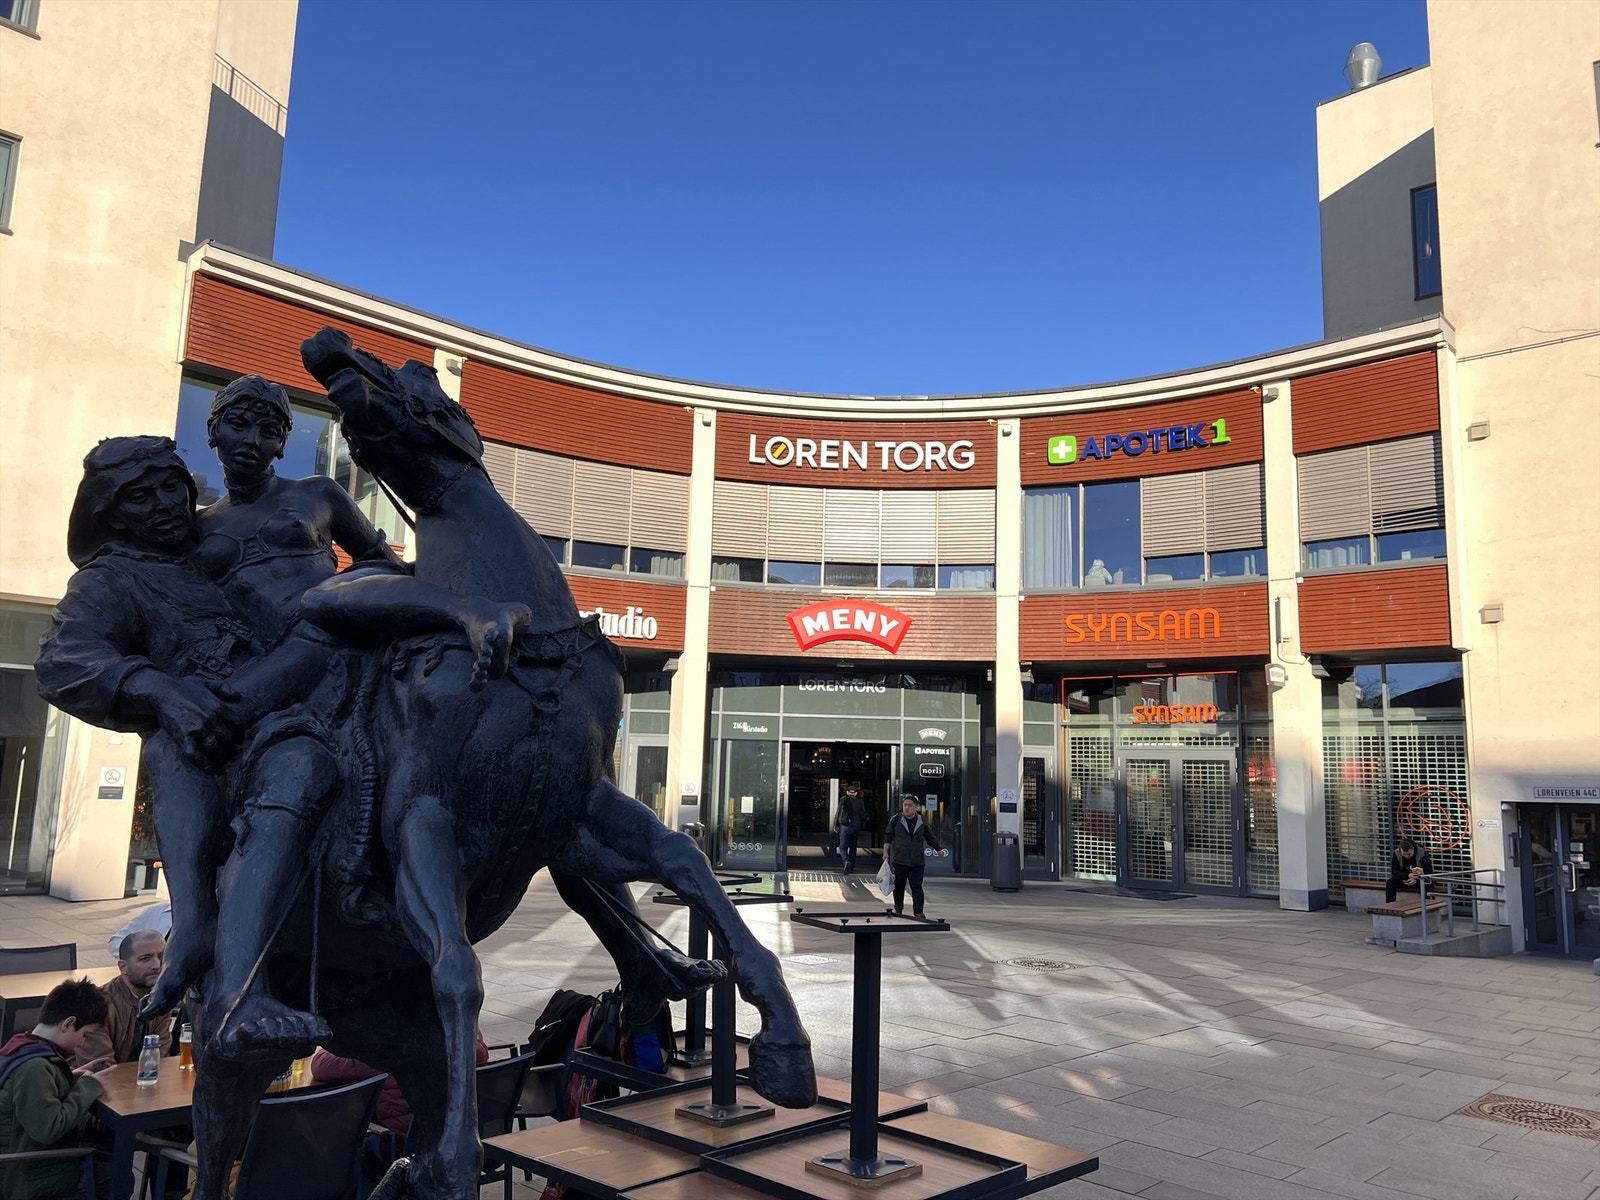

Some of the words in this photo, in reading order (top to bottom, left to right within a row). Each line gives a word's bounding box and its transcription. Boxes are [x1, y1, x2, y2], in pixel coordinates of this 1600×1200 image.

[875, 440, 976, 471] TORG
[801, 608, 900, 638] MENY
[1065, 607, 1221, 643] SYNSAM
[1132, 703, 1219, 724] SYNSAM
[921, 730, 944, 738] MENY
[1537, 789, 1581, 797] LØRENVEIEN
[1583, 789, 1597, 797] 44C
